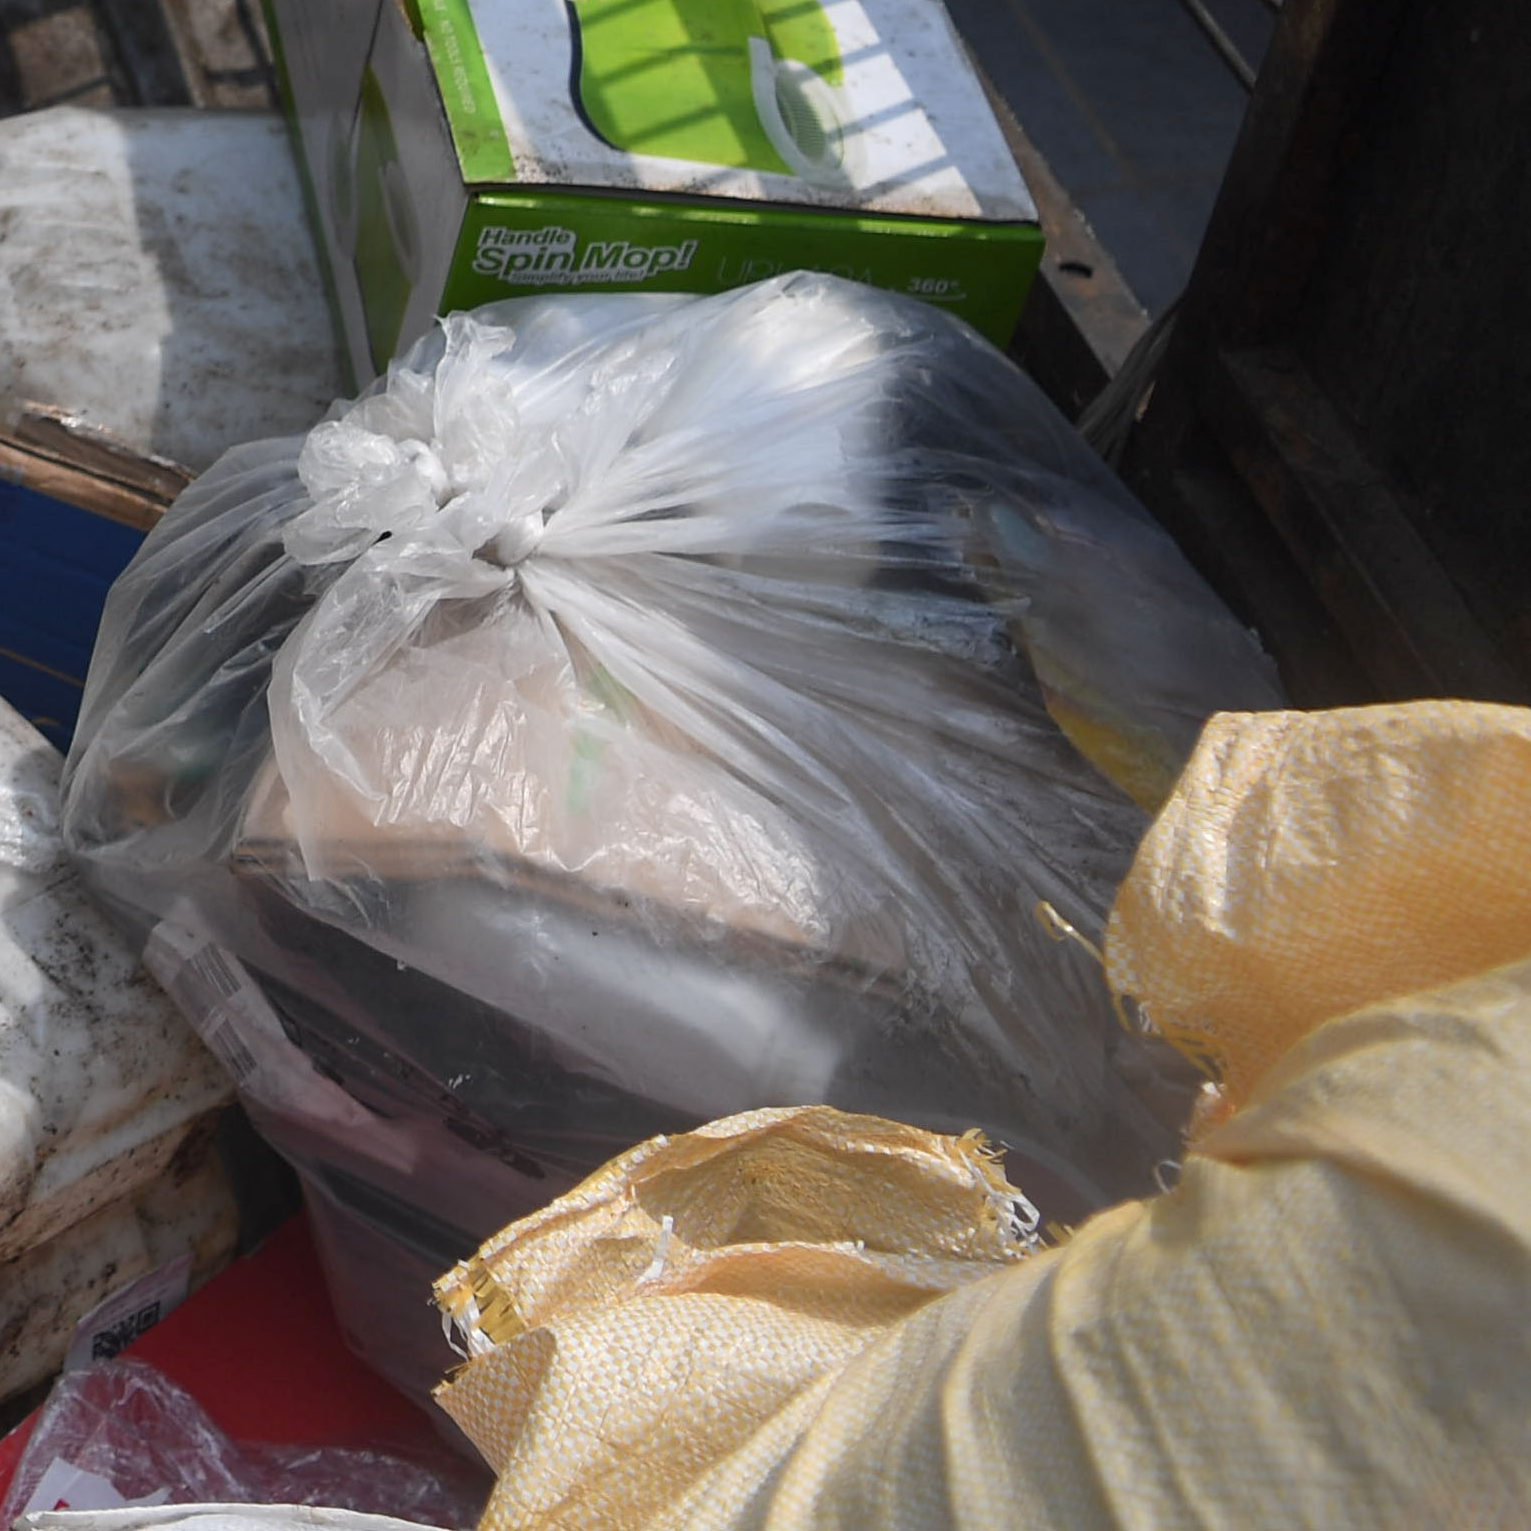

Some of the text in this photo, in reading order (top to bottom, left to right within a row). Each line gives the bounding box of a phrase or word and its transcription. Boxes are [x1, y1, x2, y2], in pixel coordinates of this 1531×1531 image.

[478, 226, 574, 247] Handle
[473, 240, 698, 277] Spin Mop!
